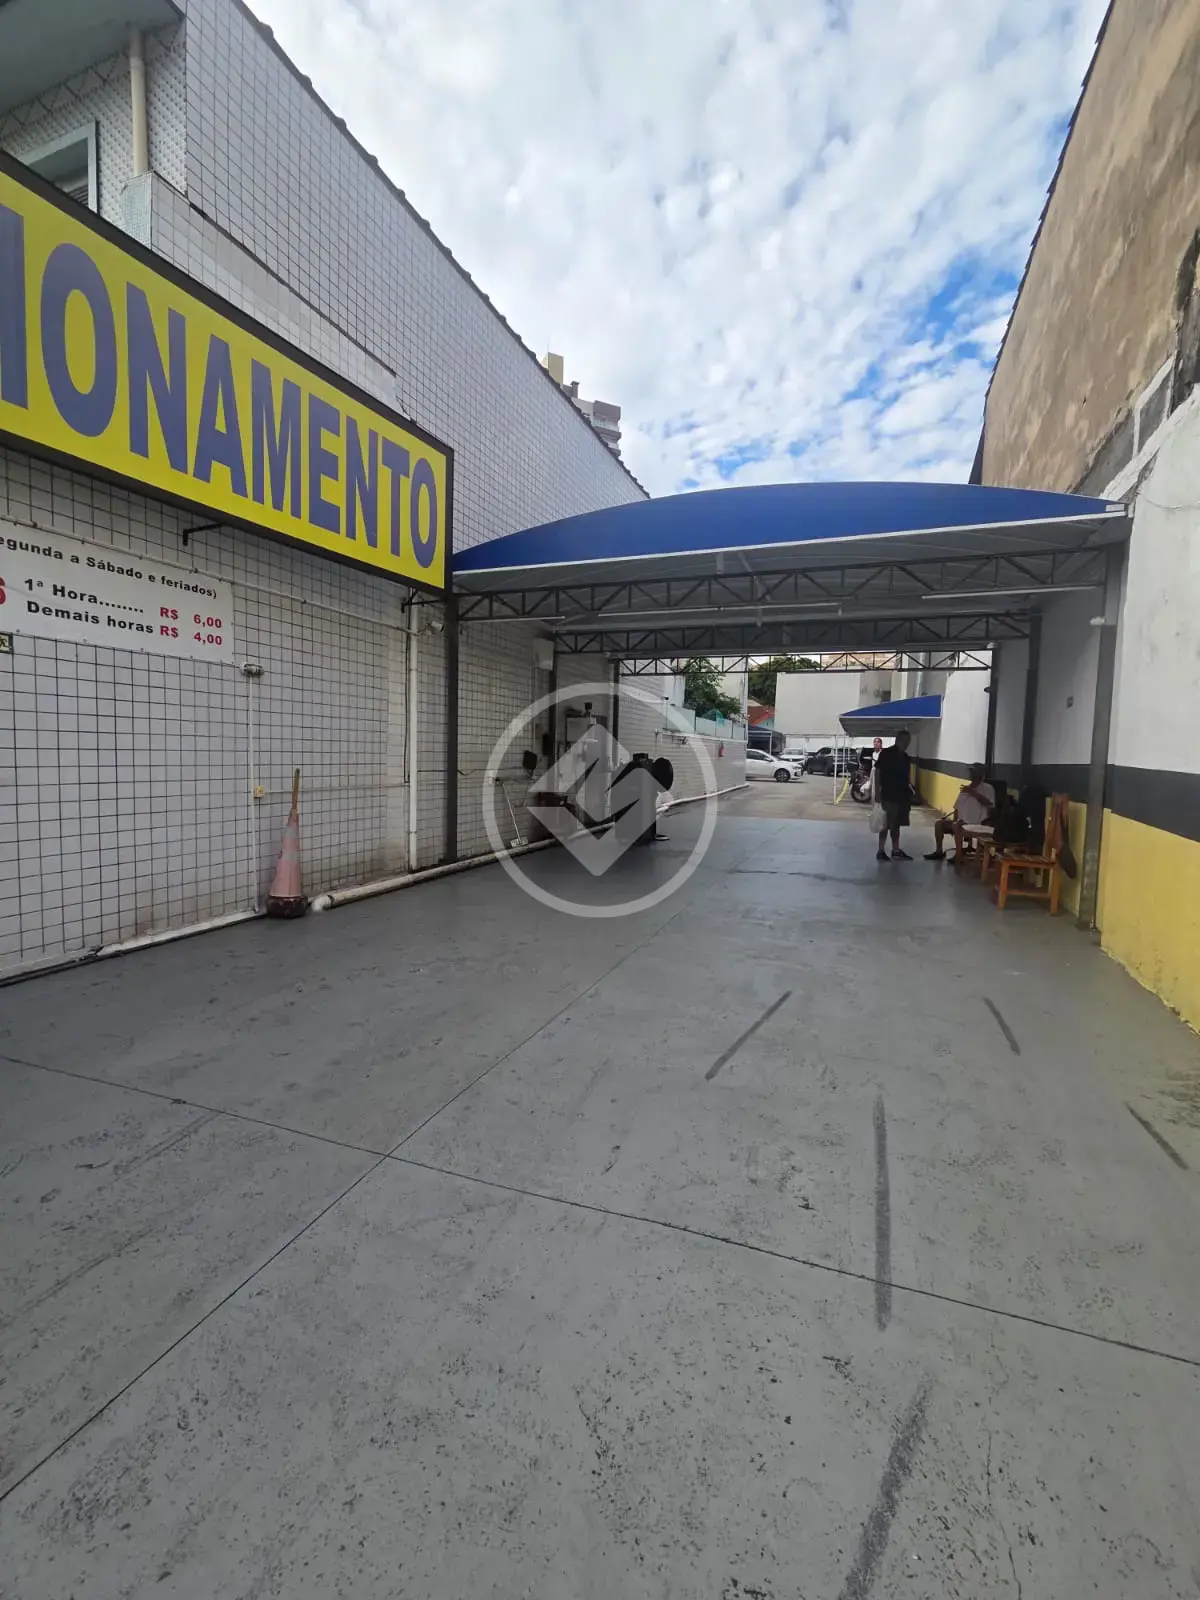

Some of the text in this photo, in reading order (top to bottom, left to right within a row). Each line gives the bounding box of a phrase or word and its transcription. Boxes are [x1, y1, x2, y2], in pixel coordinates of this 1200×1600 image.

[0, 203, 438, 568] IONAMENTO
[70, 555, 79, 564] a
[86, 556, 142, 579] Sábado
[148, 574, 156, 583] e
[161, 575, 217, 599] feriados)
[27, 600, 222, 646] Demais horas R$ 4,00
[160, 606, 179, 620] R$
[193, 614, 222, 629] 6,00
